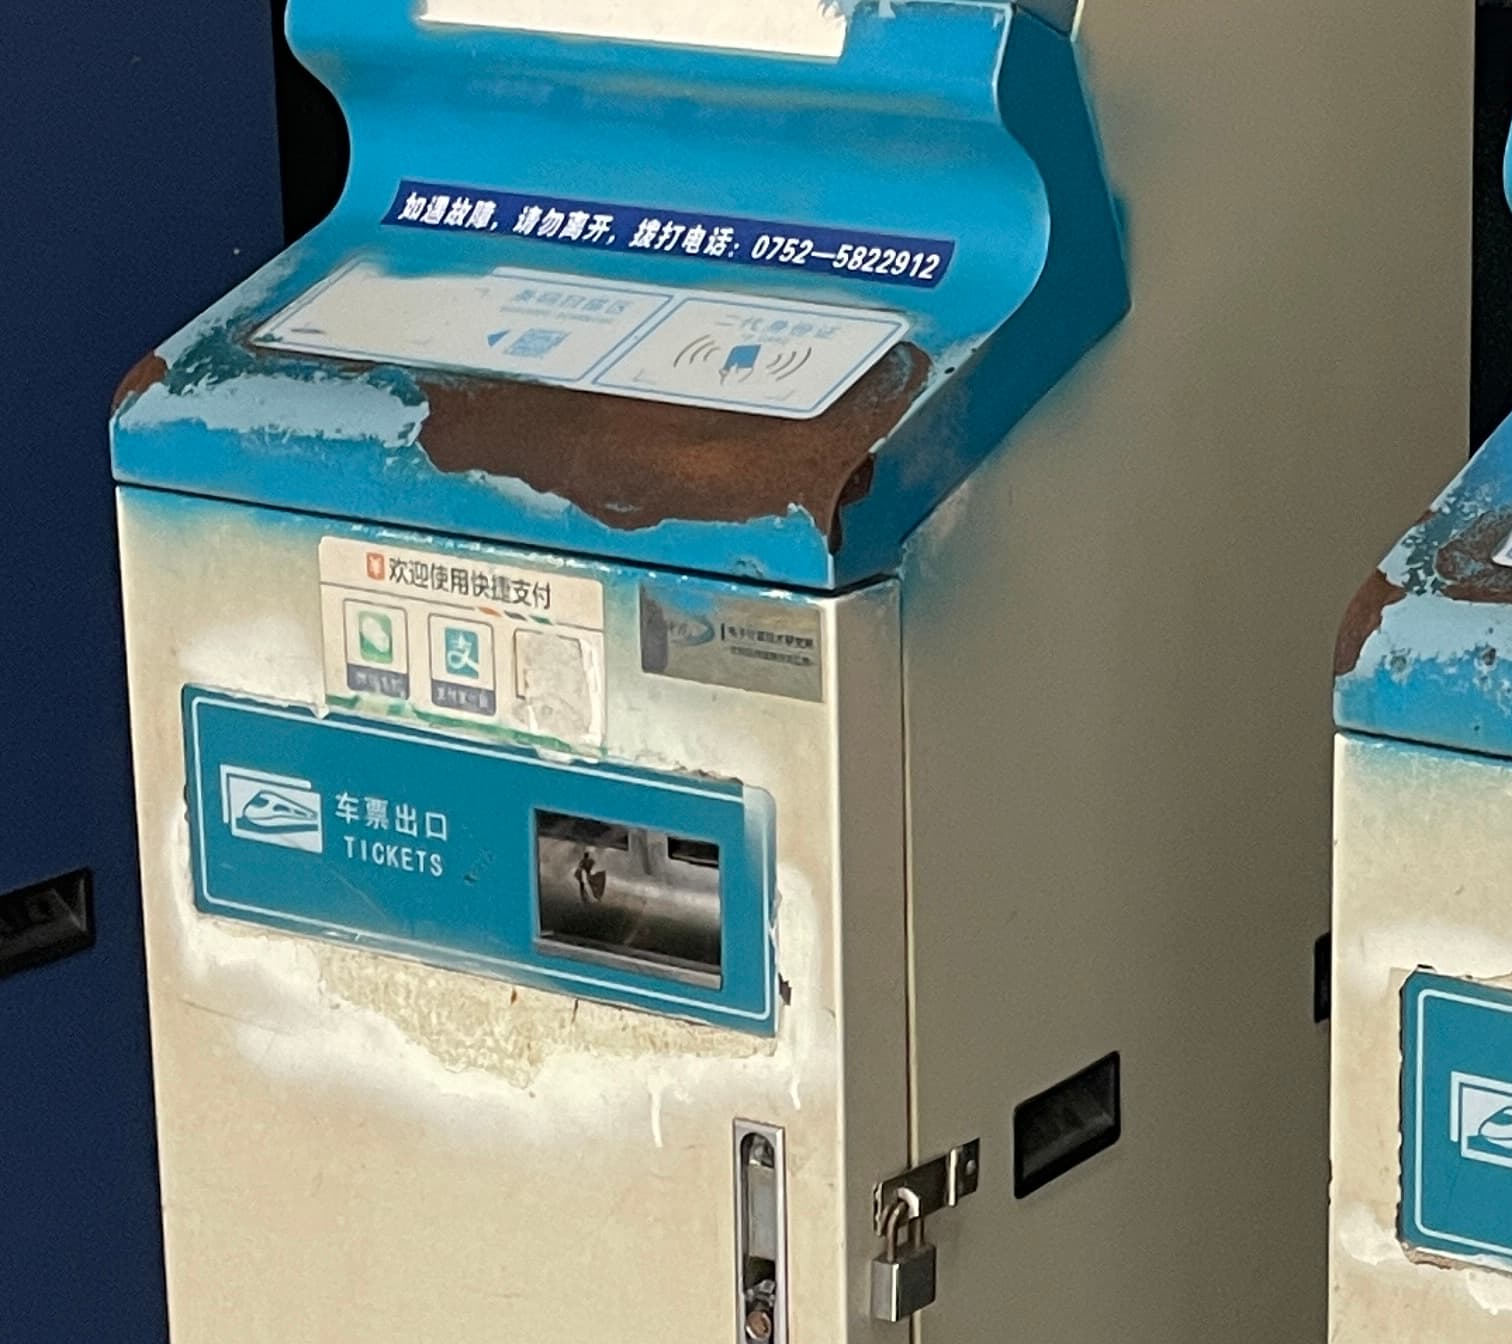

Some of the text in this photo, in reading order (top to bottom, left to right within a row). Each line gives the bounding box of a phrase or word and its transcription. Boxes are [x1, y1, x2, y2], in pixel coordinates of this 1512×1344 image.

[389, 557, 551, 610] 欢迎使用快捷支付
[334, 791, 449, 843] 车票出口
[343, 834, 445, 879] TICKETS
